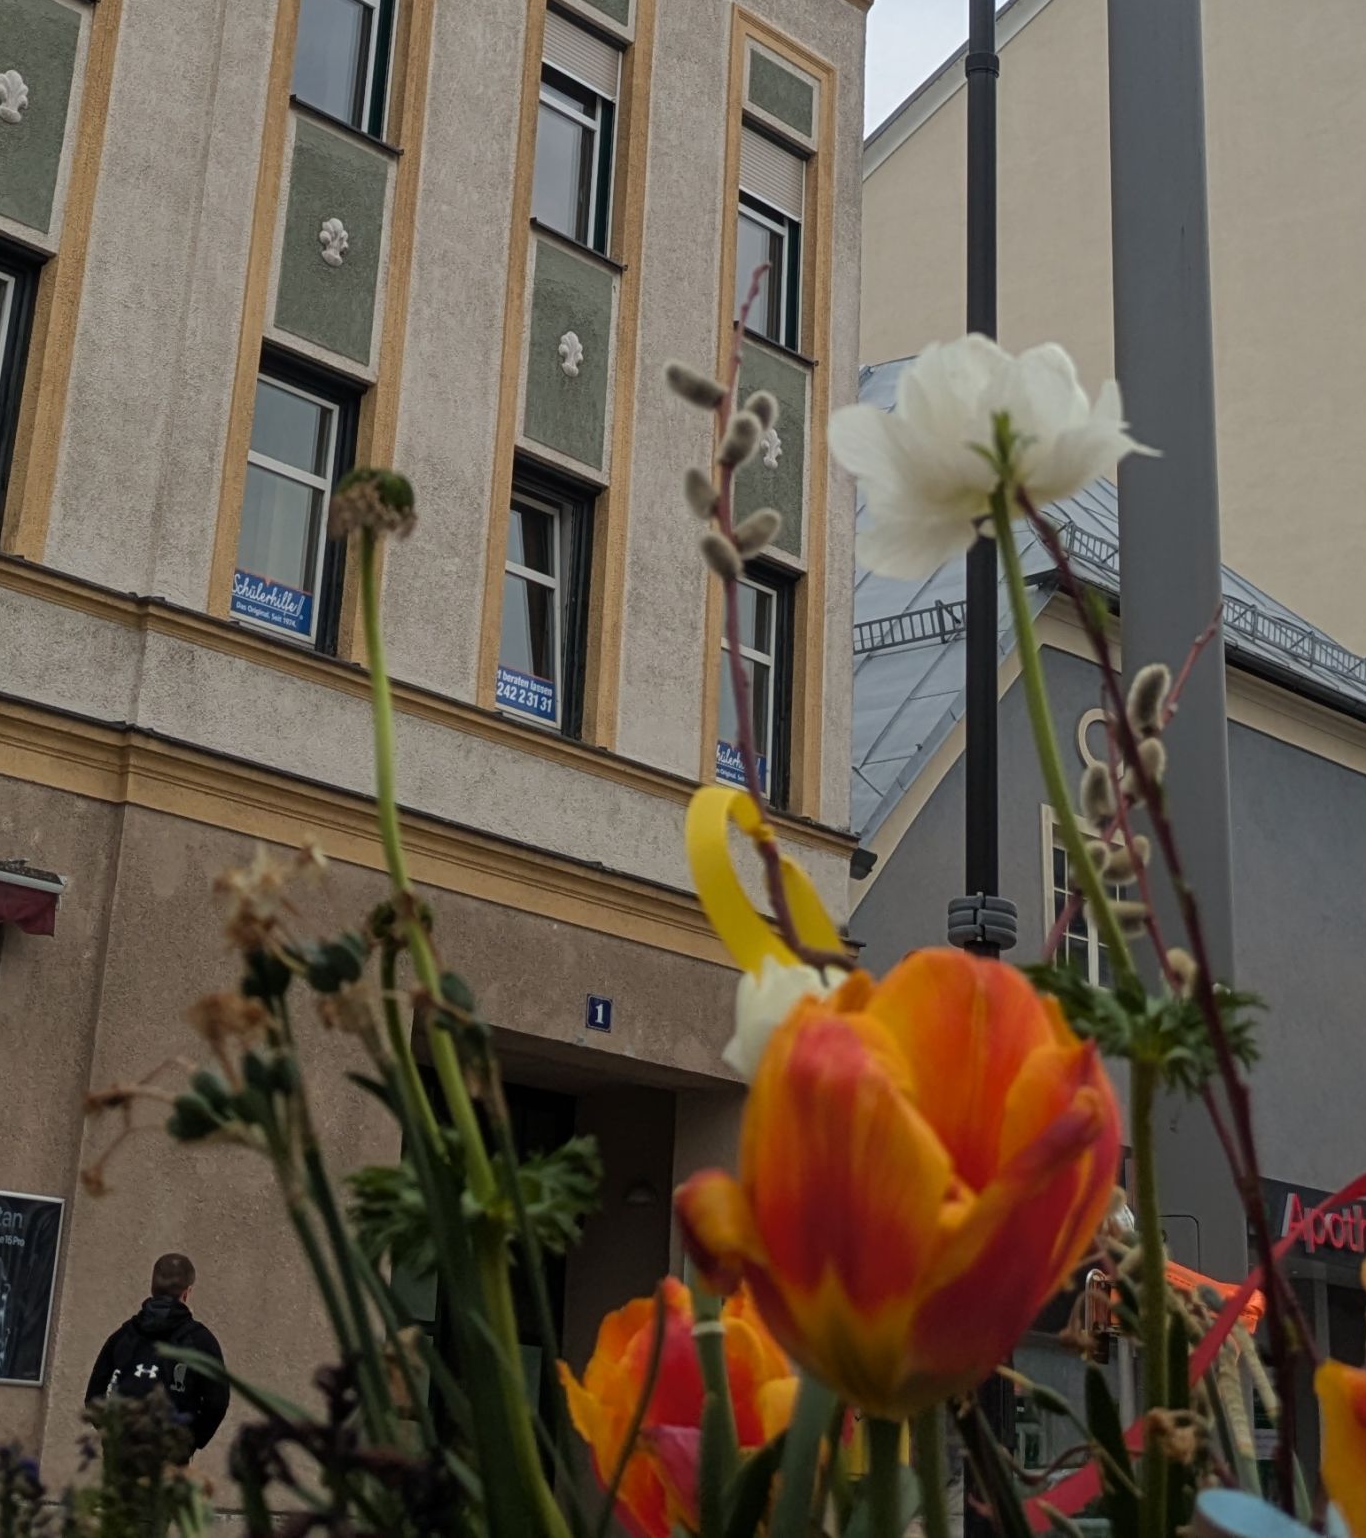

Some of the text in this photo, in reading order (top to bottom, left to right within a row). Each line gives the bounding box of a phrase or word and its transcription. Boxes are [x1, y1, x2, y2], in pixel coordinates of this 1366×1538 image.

[502, 670, 530, 688] beraten
[530, 680, 553, 697] lassen
[517, 689, 527, 704] 2
[526, 692, 539, 708] 31
[539, 697, 553, 713] 31
[595, 1003, 604, 1024] 1
[13, 1236, 26, 1247] Pro
